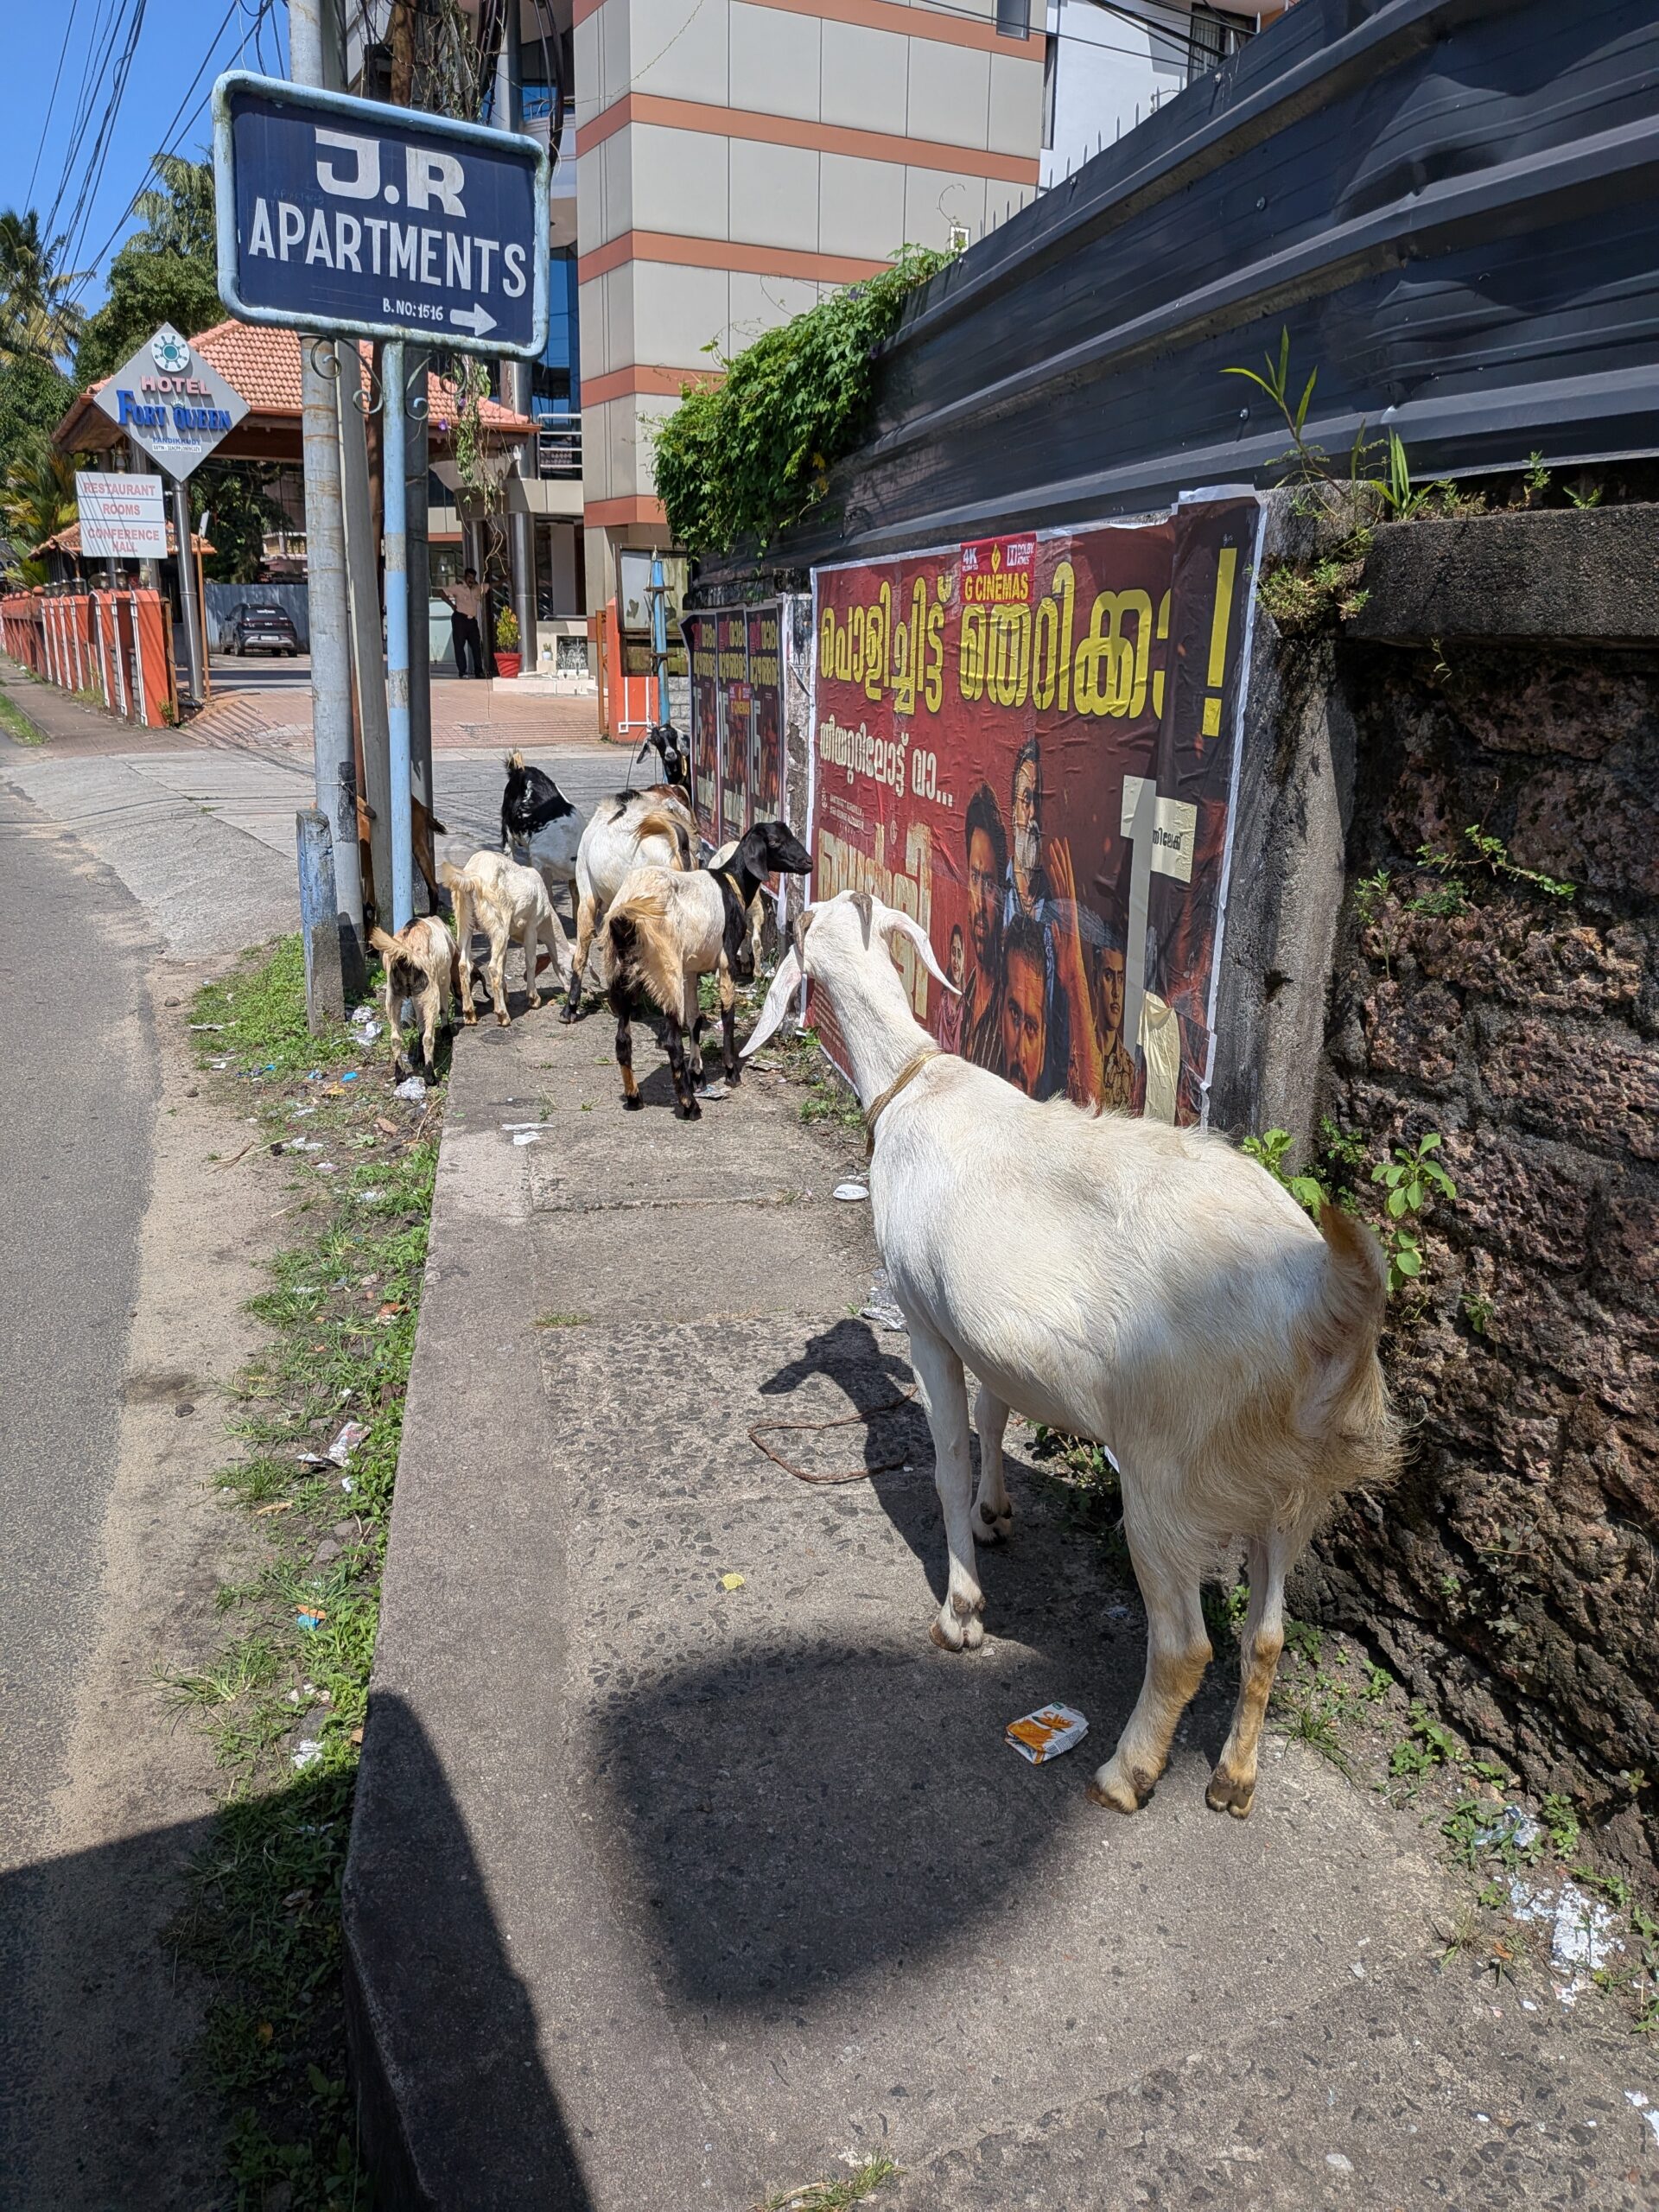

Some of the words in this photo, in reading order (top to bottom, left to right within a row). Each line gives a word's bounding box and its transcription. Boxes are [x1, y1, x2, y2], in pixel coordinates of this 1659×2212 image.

[315, 127, 467, 218] J.R
[248, 197, 527, 298] APARTMENTS
[141, 375, 212, 395] HOTEL
[173, 404, 232, 431] QUEEN
[83, 482, 156, 497] RESTAURANT
[102, 503, 141, 516] ROOMS
[87, 527, 160, 541] CONFERENCE
[963, 547, 978, 565] 4K
[1017, 542, 1035, 556] DOLBY
[964, 575, 973, 601] G
[975, 571, 1029, 602] CINEMAS
